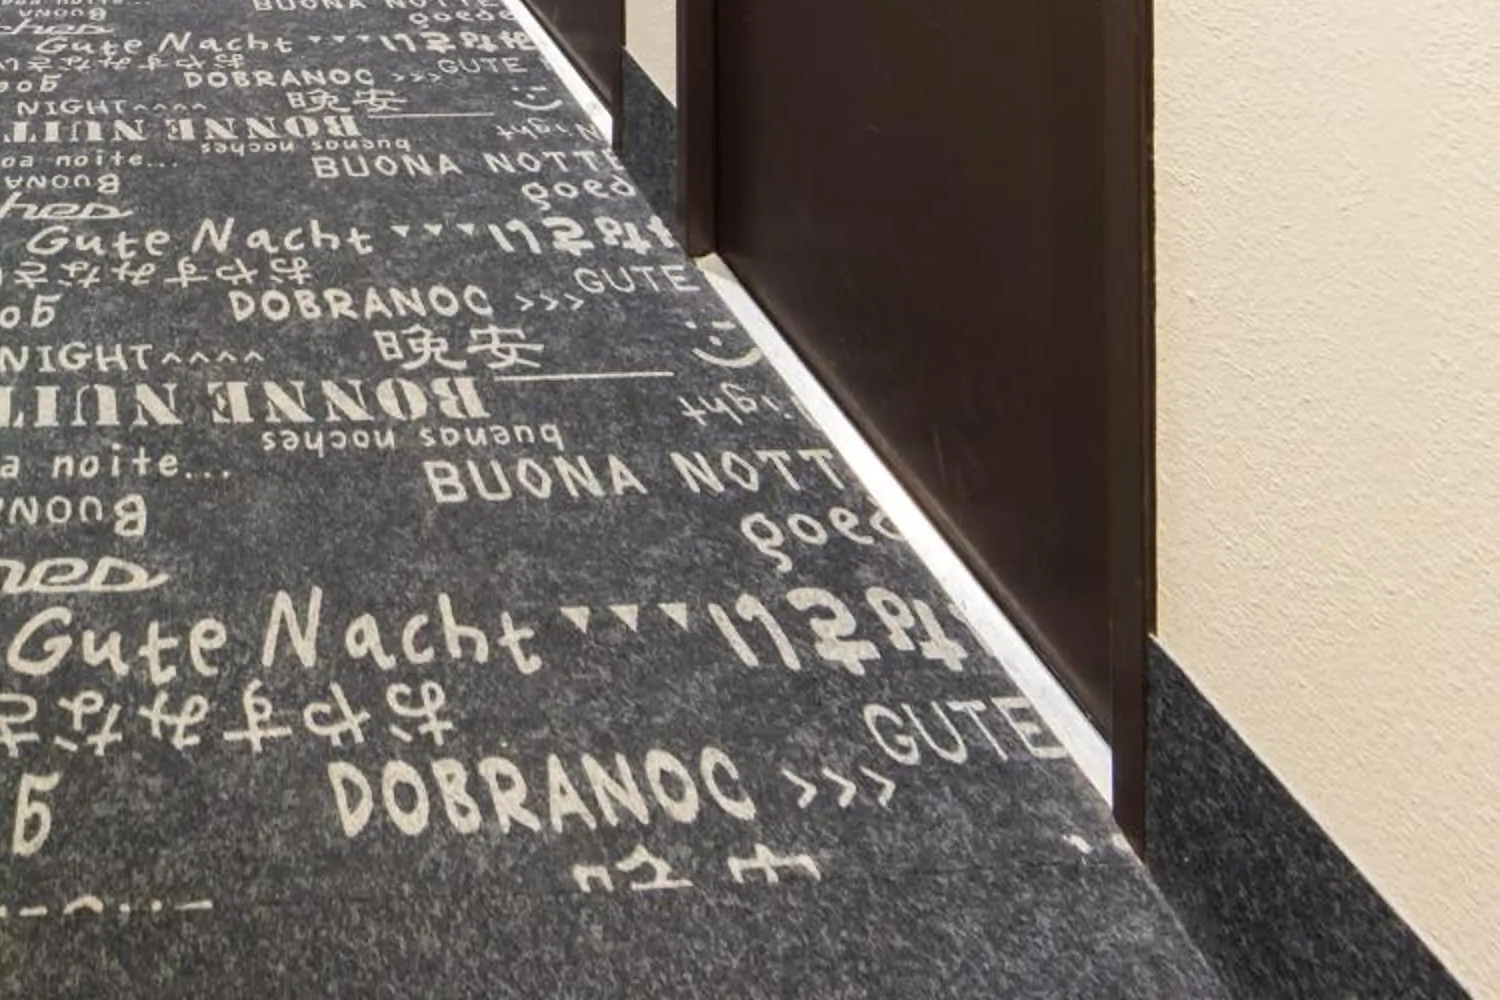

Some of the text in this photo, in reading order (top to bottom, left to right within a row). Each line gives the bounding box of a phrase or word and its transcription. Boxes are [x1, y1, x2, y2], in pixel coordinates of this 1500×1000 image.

[36, 31, 293, 56] Gute Nacht
[184, 69, 375, 89] DOBRANOC
[437, 57, 528, 76] GUTE
[3, 120, 147, 143] NUIT
[164, 116, 362, 141] BONNE
[312, 155, 463, 179] BUONA
[26, 217, 373, 261] Gute Nacht
[575, 264, 701, 294] GUTE
[228, 285, 494, 321] DOBRANOC
[207, 376, 493, 423] BONNE
[263, 423, 564, 454] buenas noches
[423, 453, 647, 504] BUONA
[7, 587, 543, 685] Gute Nacht
[862, 696, 1070, 766] GUTE
[328, 747, 756, 837] DOBRANOC
